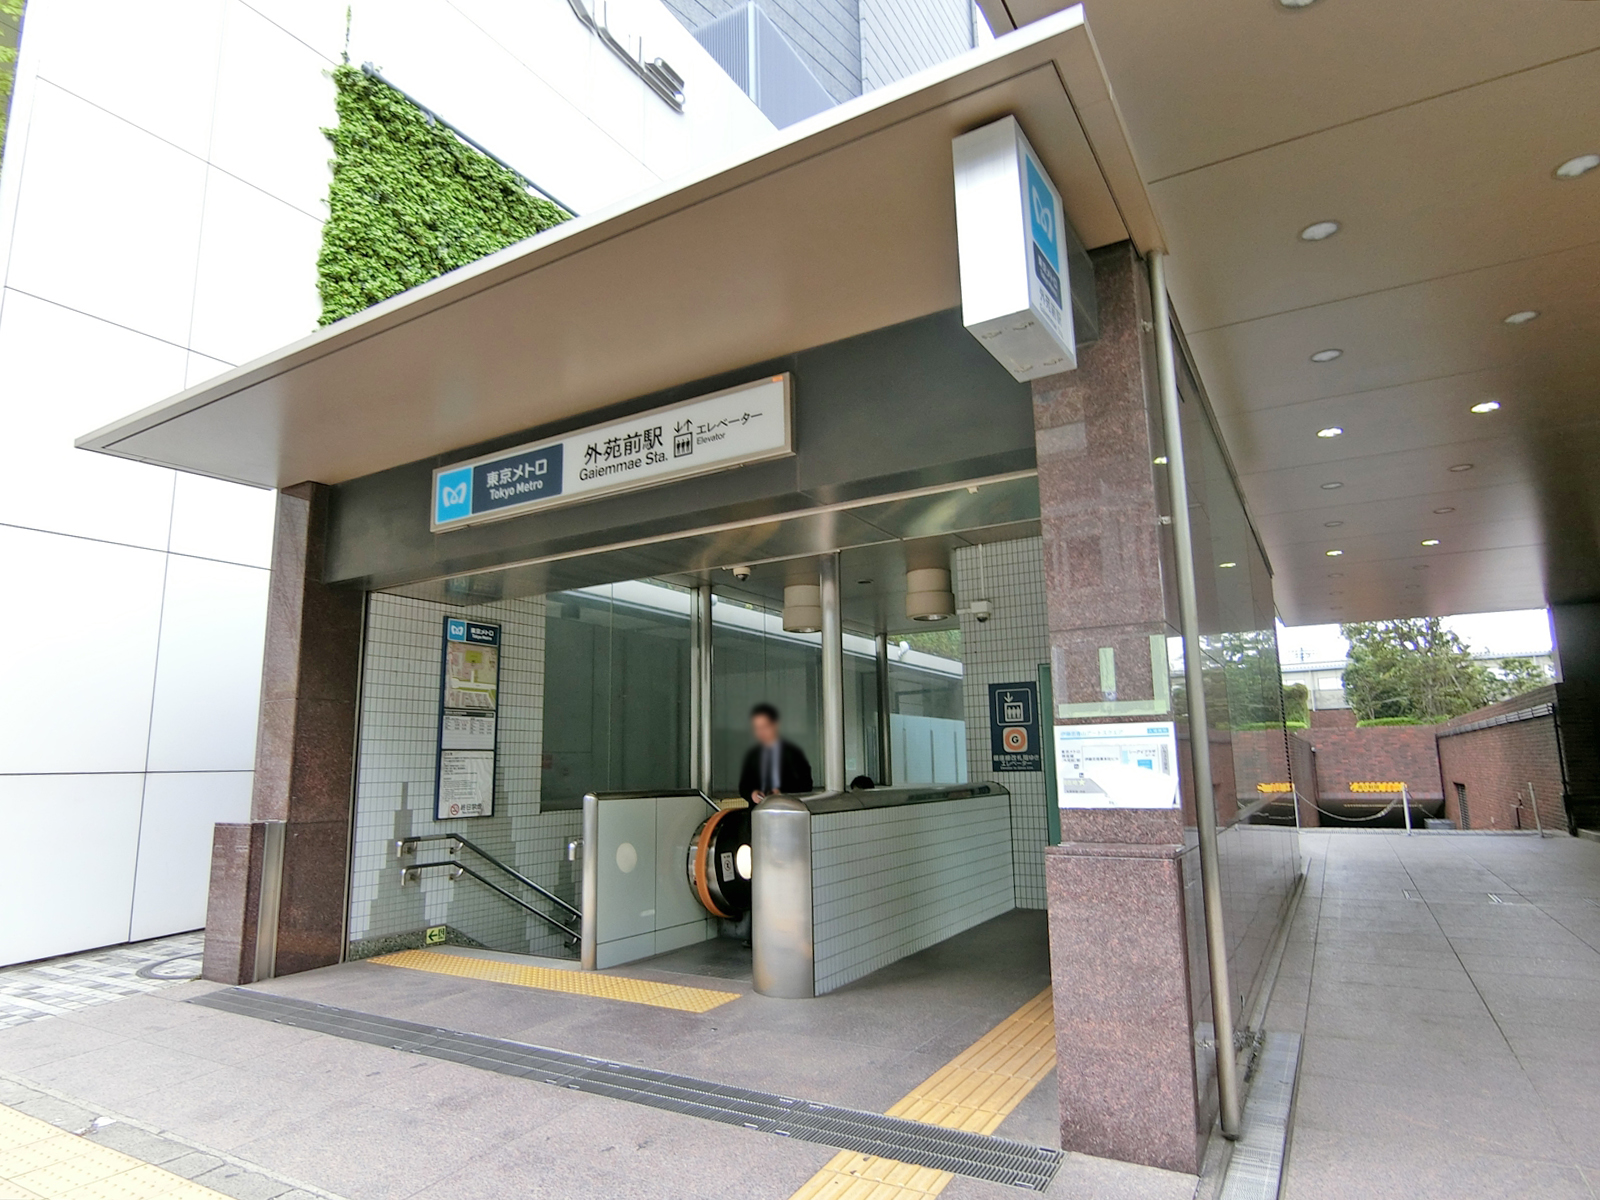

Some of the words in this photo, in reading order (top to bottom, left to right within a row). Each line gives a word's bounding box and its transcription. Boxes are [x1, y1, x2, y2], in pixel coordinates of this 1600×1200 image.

[695, 412, 763, 436] エレベーター
[584, 425, 663, 466] 外苑前駅
[696, 432, 726, 445] Elevator
[486, 458, 548, 488] 東京メトロ
[579, 457, 642, 481] Gaiemmae
[645, 451, 668, 466] Sta.
[489, 486, 515, 500] Tokyo
[516, 479, 544, 494] Metro
[1011, 735, 1019, 744] G
